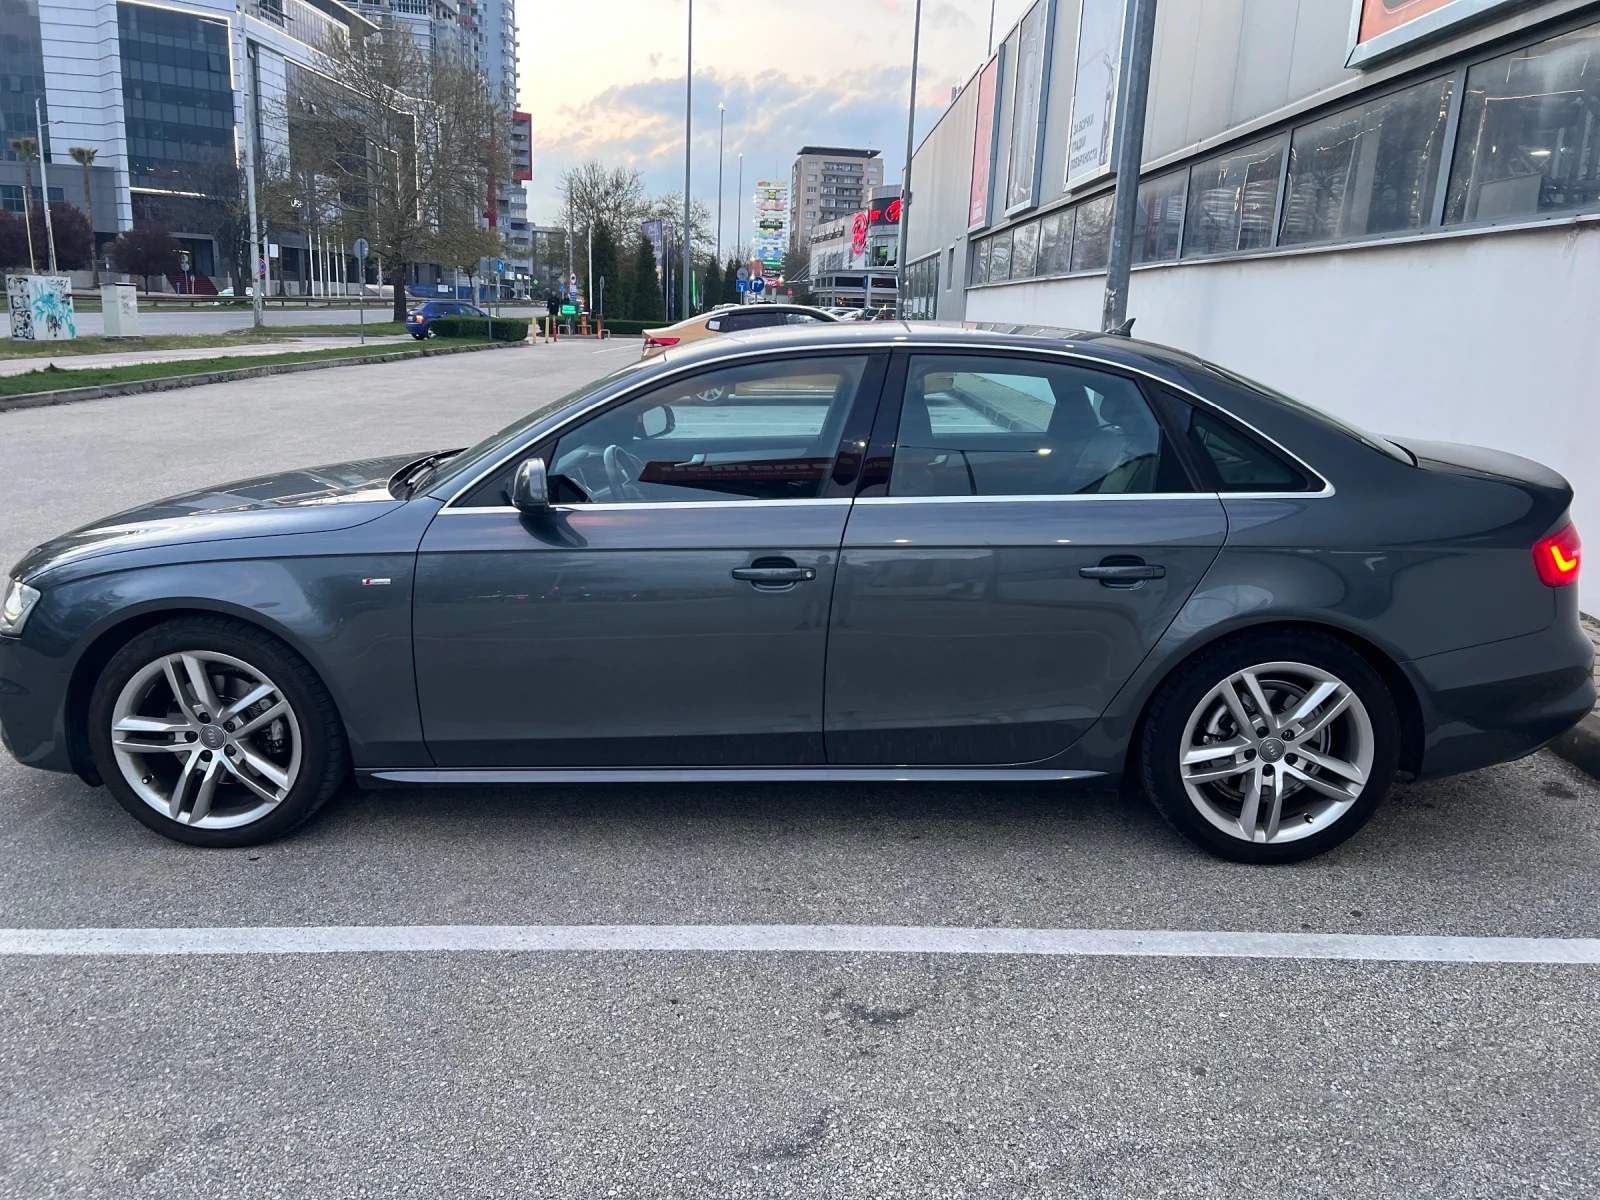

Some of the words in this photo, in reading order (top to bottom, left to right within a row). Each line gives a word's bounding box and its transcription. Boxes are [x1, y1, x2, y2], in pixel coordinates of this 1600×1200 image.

[1079, 112, 1095, 132] ВСИЧКИ
[1072, 135, 1087, 153] ГЛАДКИ
[1070, 147, 1098, 170] ПОВЪРХНОСТИ
